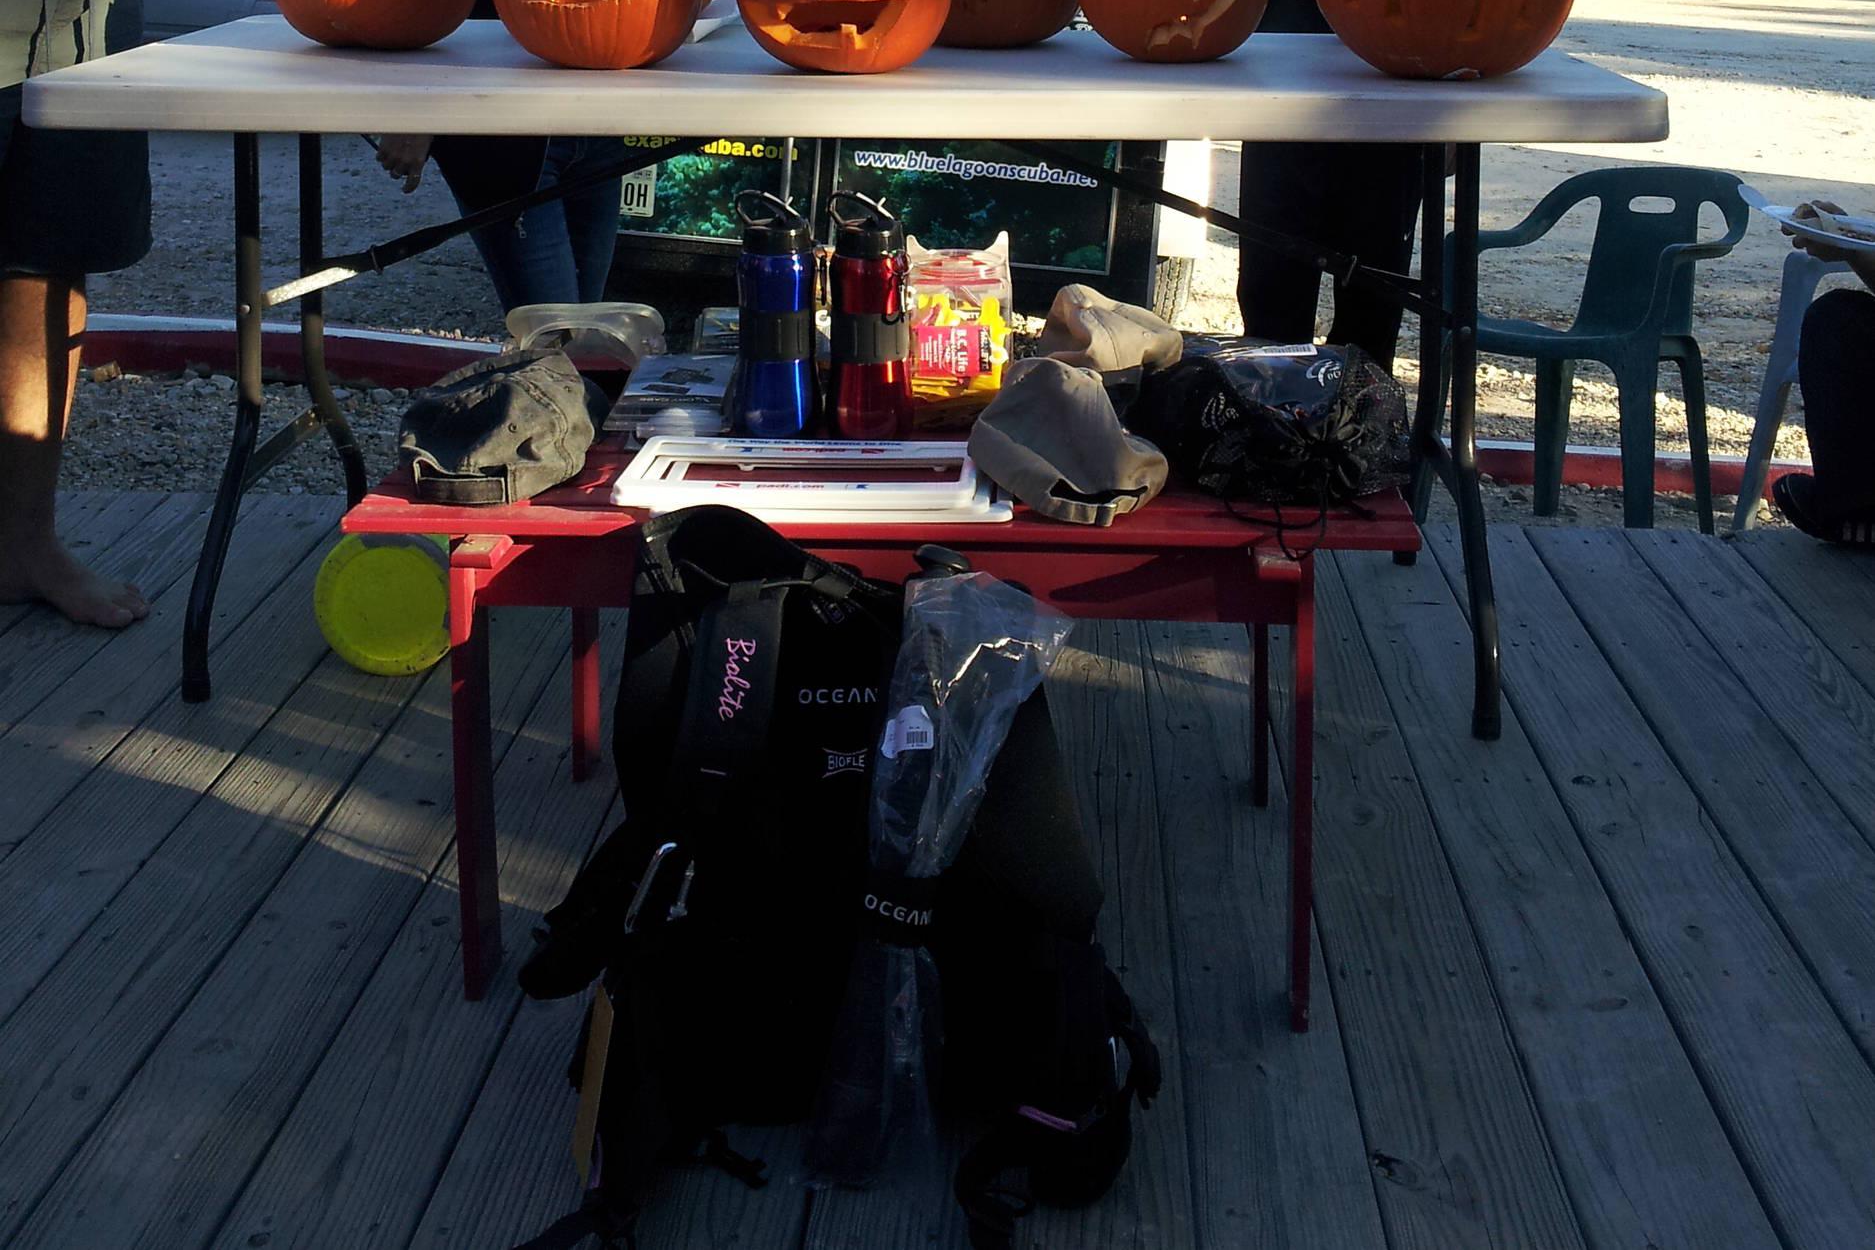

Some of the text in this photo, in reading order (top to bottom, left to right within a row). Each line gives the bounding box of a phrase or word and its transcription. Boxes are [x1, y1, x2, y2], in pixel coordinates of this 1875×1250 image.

[957, 350, 969, 373] Life
[799, 687, 878, 704] OCEAN
[827, 753, 865, 771] BIOFLE
[864, 893, 933, 926] OCEAN
